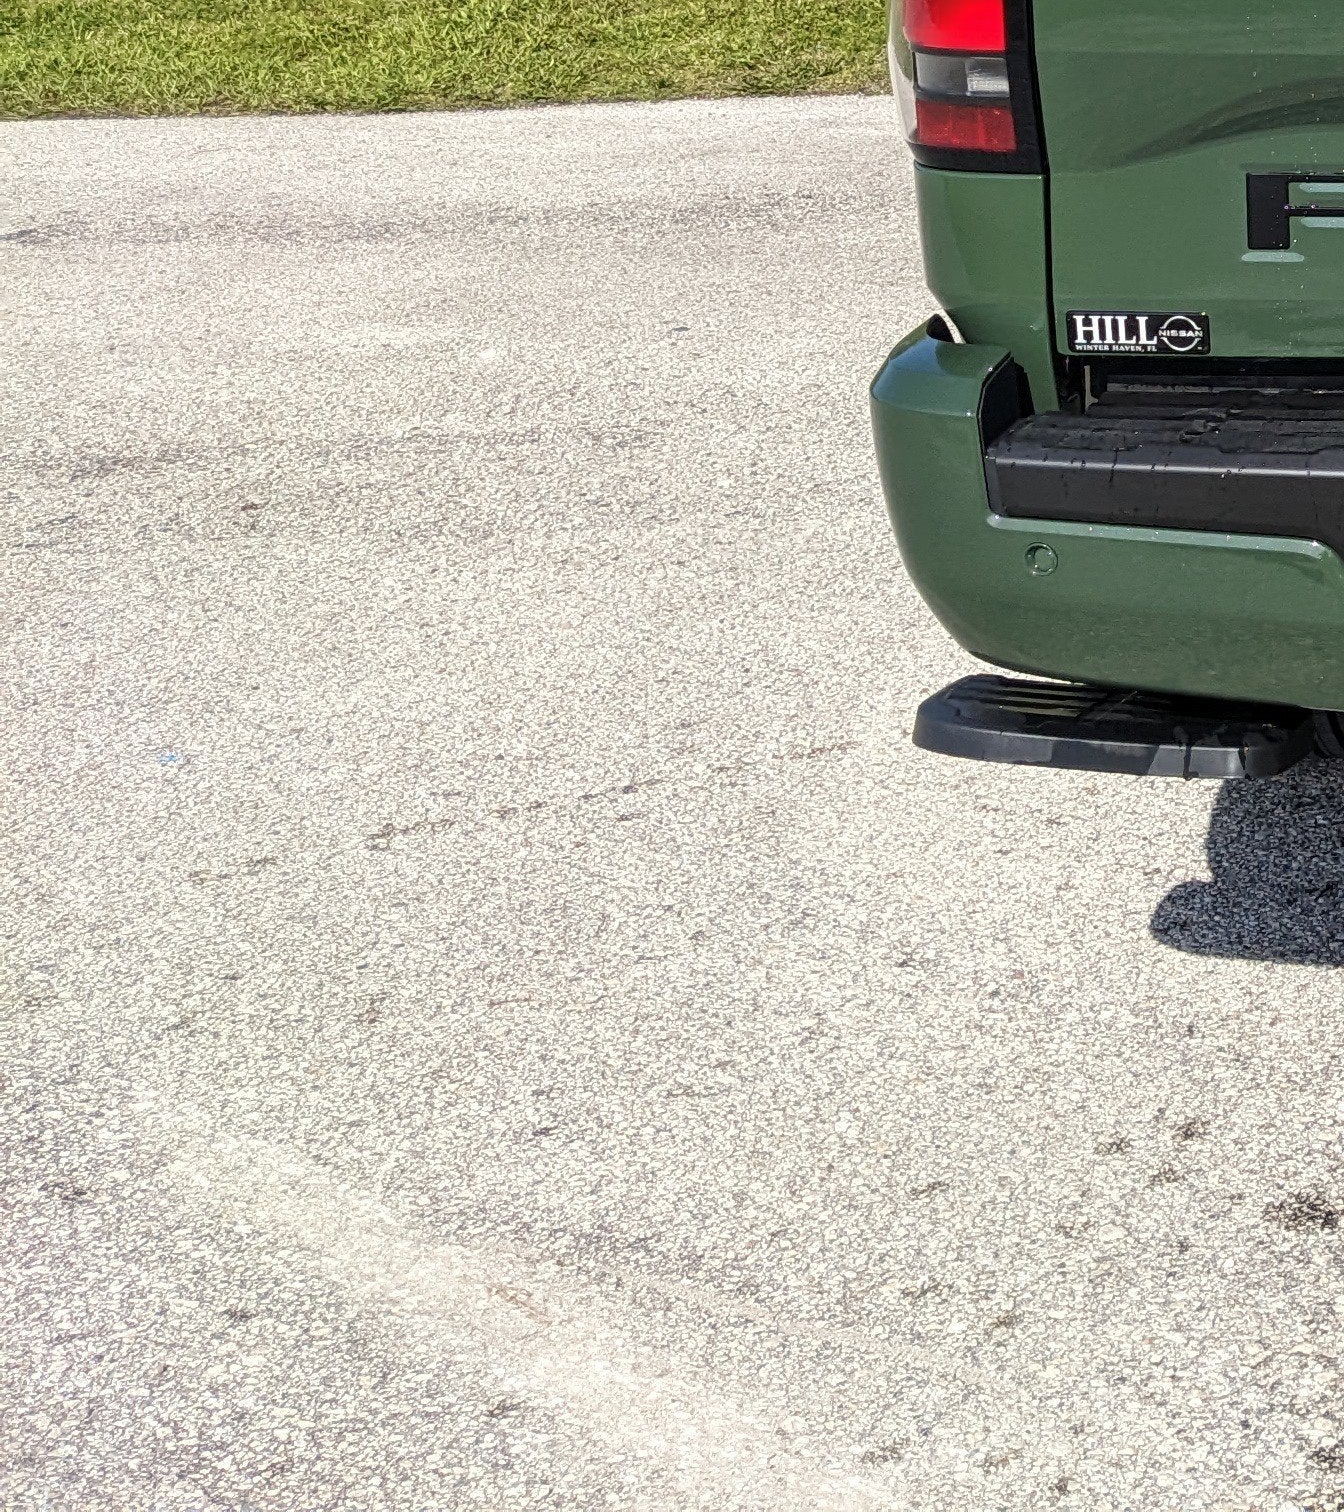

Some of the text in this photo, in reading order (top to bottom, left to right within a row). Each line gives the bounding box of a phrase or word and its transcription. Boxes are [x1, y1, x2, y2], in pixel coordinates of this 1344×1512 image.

[1072, 315, 1158, 345] HILL
[1158, 329, 1204, 338] NISSAN
[1112, 345, 1145, 353] HAVEN,
